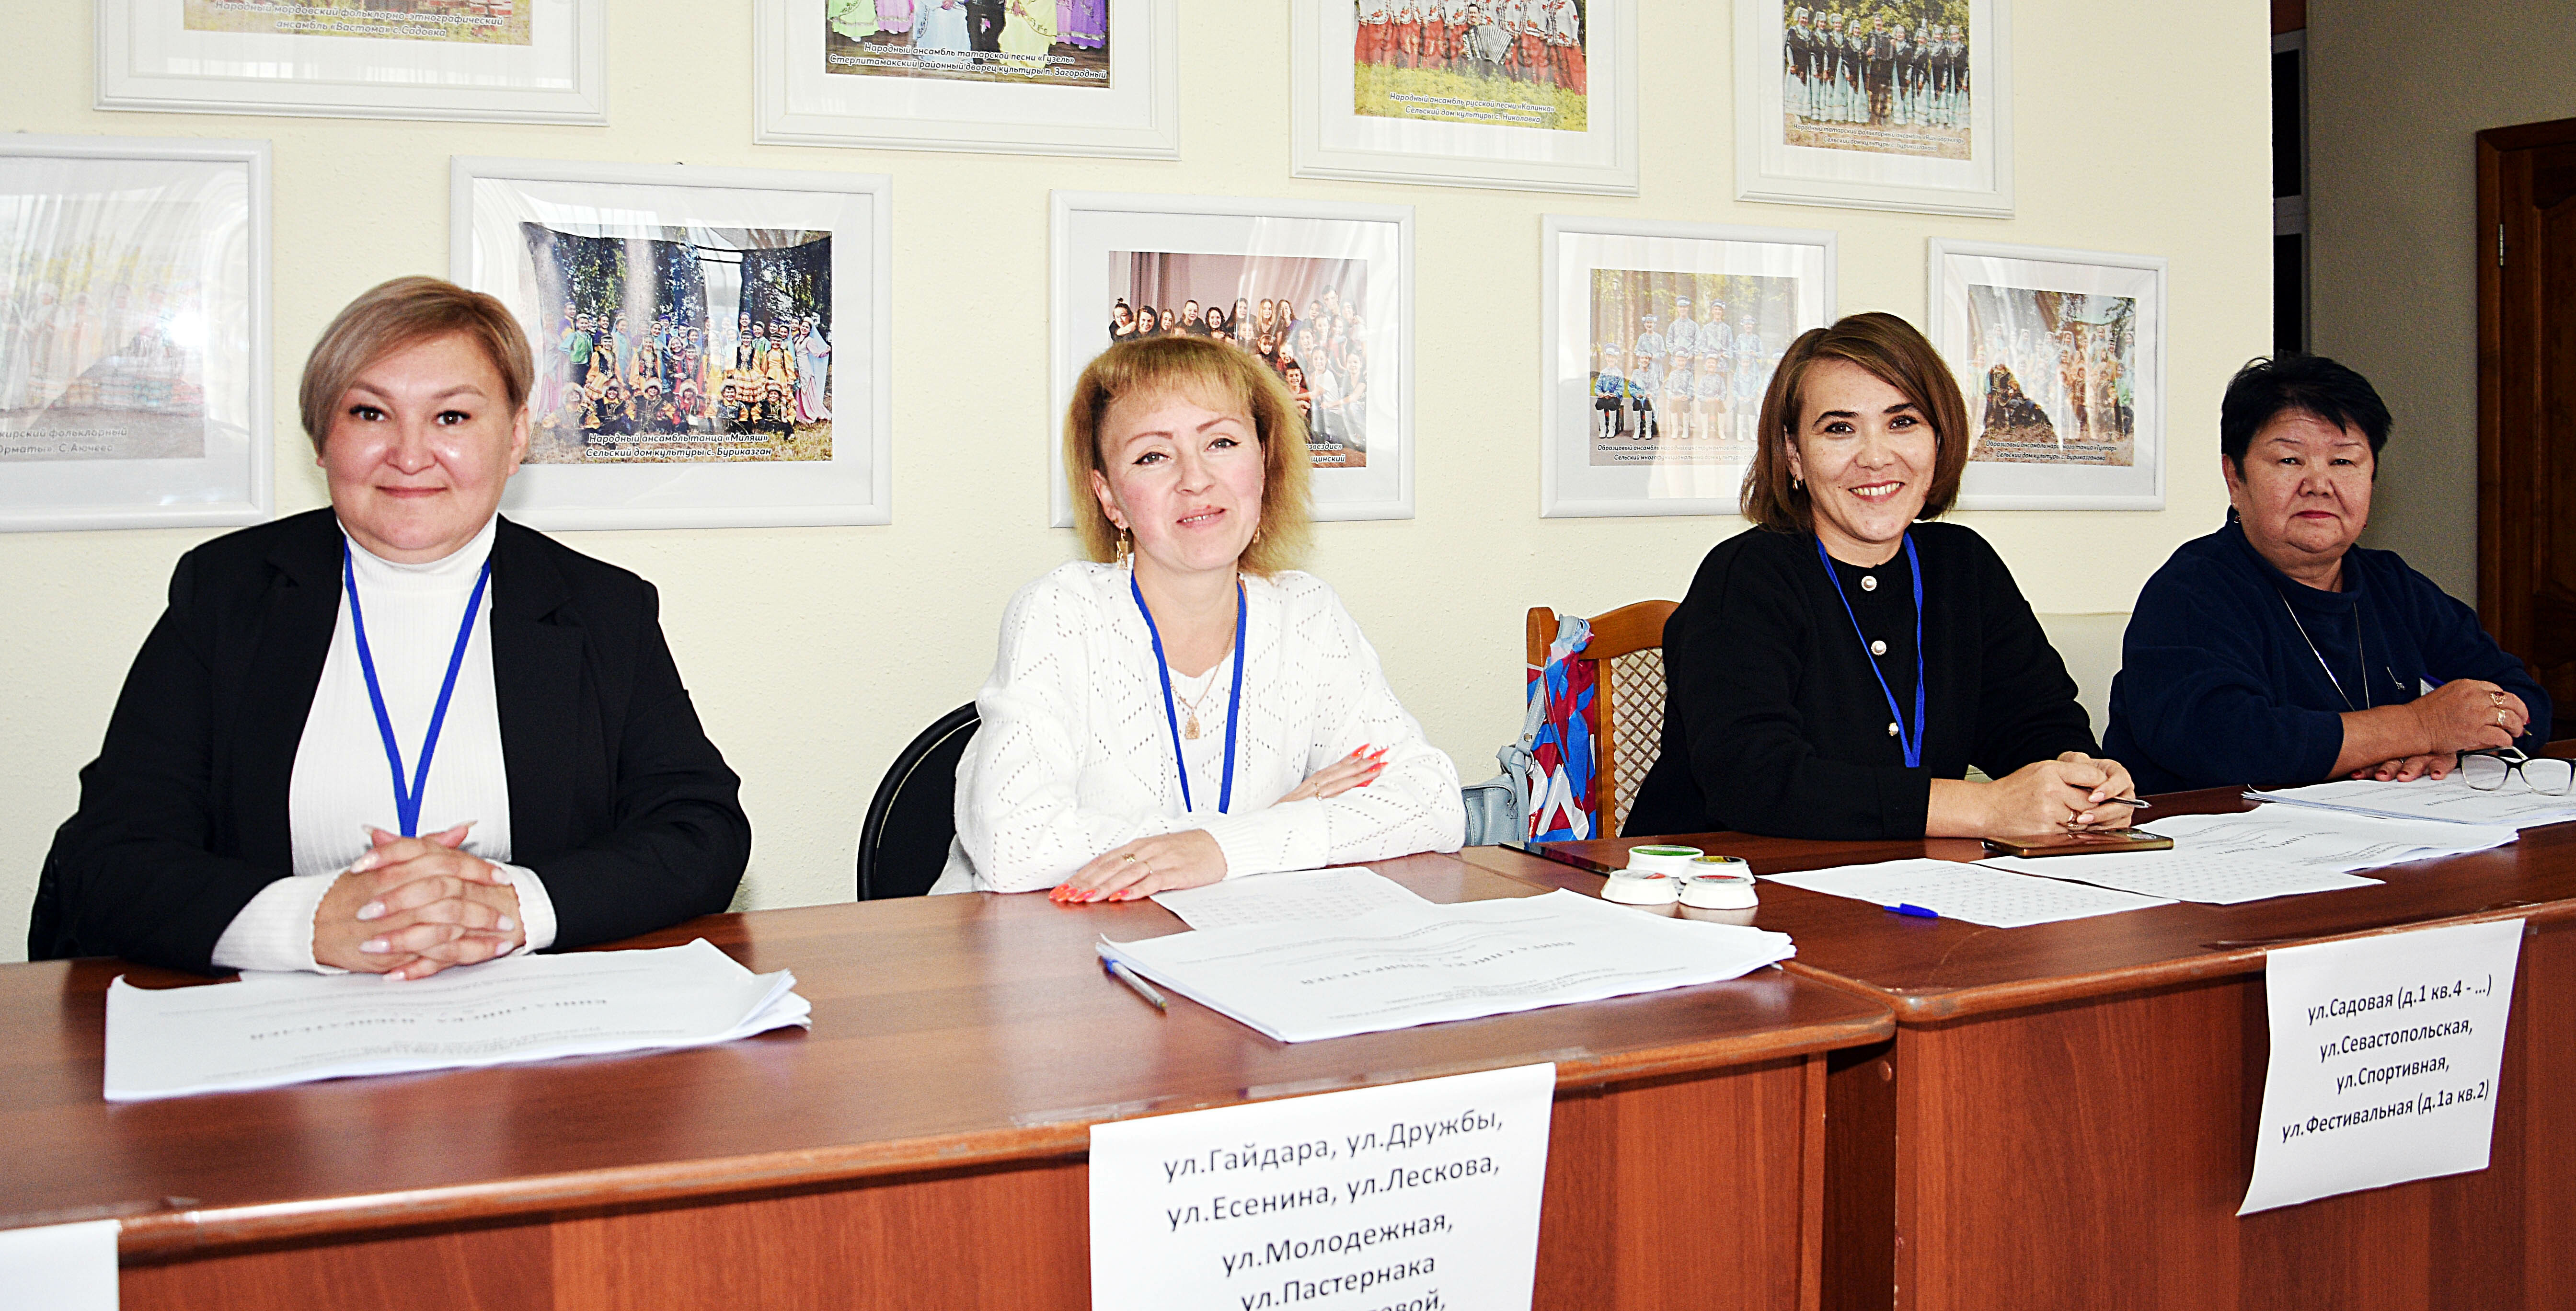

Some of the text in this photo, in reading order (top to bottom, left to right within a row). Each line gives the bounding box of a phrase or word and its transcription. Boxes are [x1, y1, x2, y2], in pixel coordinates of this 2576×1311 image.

[216, 0, 503, 25] Народный мордовский фольклорно-этнографический
[276, 21, 327, 30] ансамбль
[864, 43, 910, 54] Народный
[913, 48, 955, 57] ансамбль
[957, 51, 1009, 60] татарской
[1038, 54, 1074, 63] «Гузель»
[829, 55, 917, 67] Стерлитамакский
[919, 61, 964, 69] районный
[966, 63, 997, 73] дворец
[999, 67, 1043, 75] культуры
[1055, 68, 1106, 78] Загородный
[1390, 92, 1428, 102] Народный
[1518, 104, 1554, 112] «Калинка»
[1405, 106, 1439, 115] Сельский
[1503, 114, 1540, 123] Николавка
[49, 427, 127, 438] фольклорный
[589, 433, 640, 445] Народный
[642, 433, 688, 442] ансамбль
[725, 433, 768, 442] «Миляш»
[586, 448, 631, 457] Сельский
[634, 448, 653, 456] дом
[654, 449, 704, 458] культуры
[717, 448, 771, 457] Буриказган
[2309, 994, 2392, 1025] ул.Садовая
[2398, 985, 2425, 1009] (д.1
[2431, 980, 2461, 1000] кв.4
[2320, 1020, 2472, 1062] ул.Севастопольская,
[2337, 1057, 2449, 1094] ул.Спортивная,
[2282, 1079, 2488, 1143] ул.Фестивальная (д.1а кв.2)
[1164, 1109, 1502, 1183] ул.Гайдара, ул.Дружбы,
[1168, 1157, 1499, 1231] ул.Есенина, ул.Лескова,
[1223, 1214, 1452, 1276] ул.Молодежная,
[1242, 1257, 1434, 1311] ул.Пастернака
